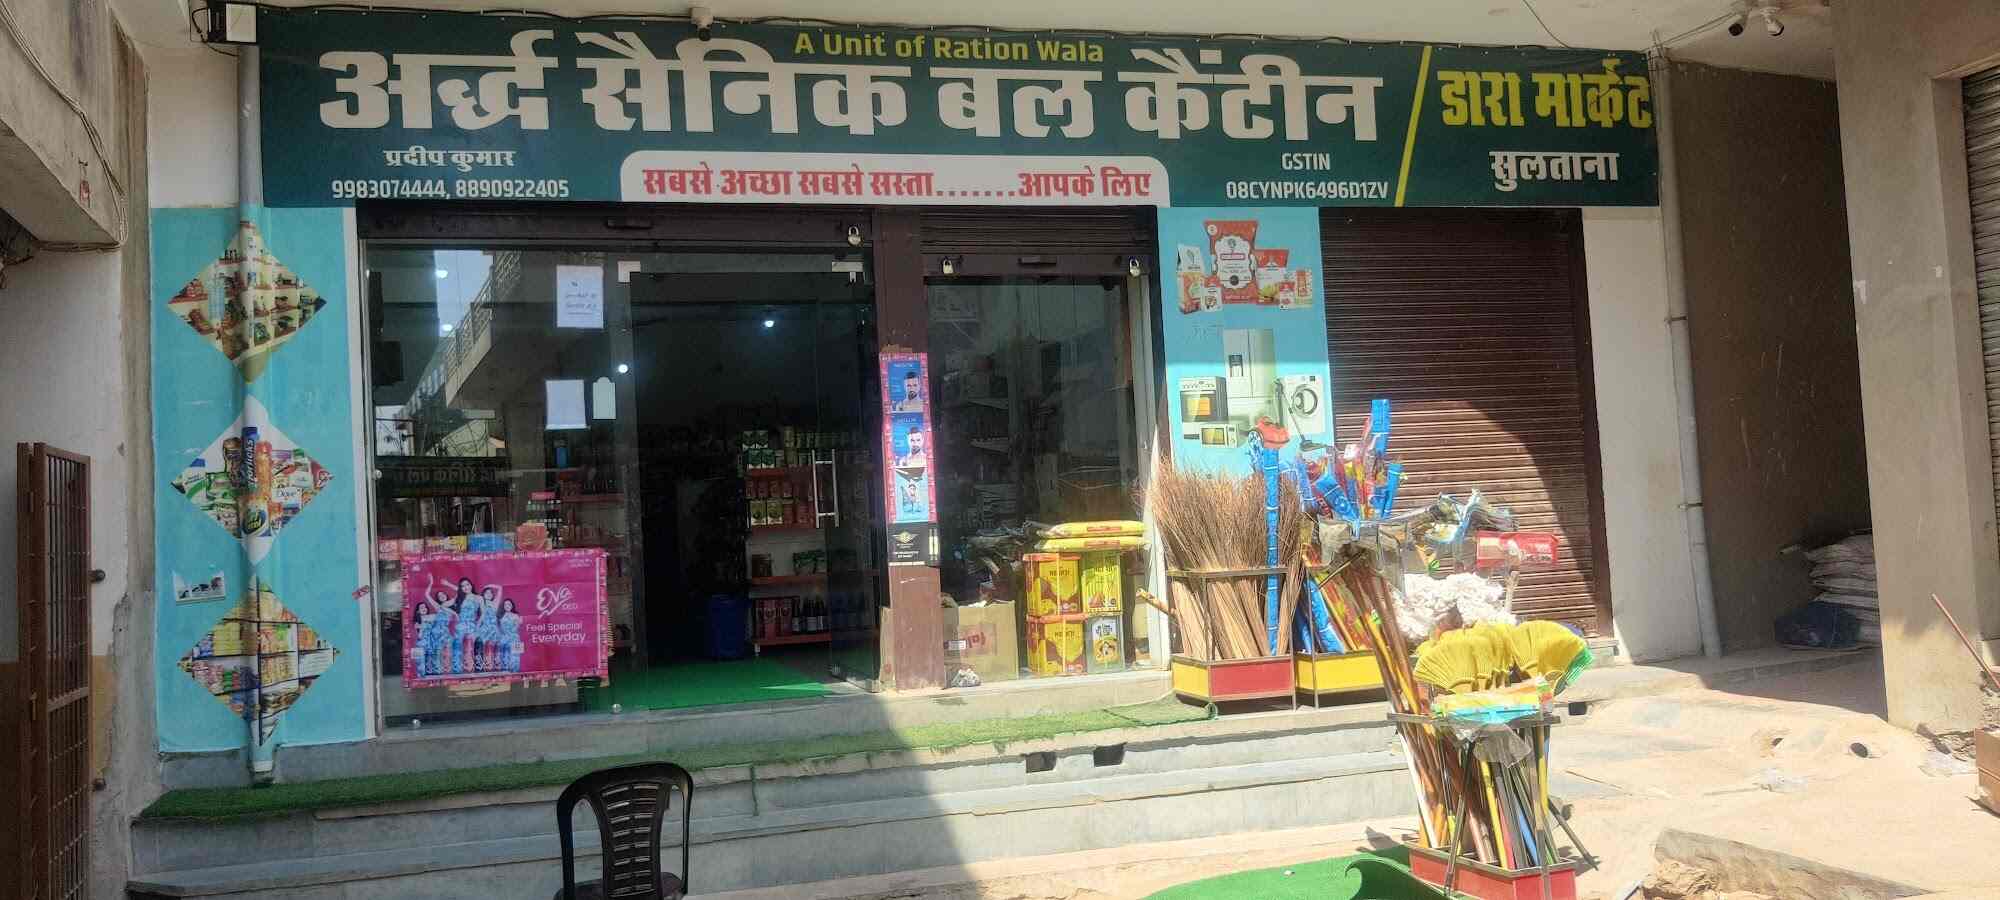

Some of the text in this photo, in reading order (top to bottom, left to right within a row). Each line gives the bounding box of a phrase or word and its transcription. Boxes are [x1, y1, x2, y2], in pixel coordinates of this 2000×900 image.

[795, 32, 1104, 63] A Unit of Ration Wala
[575, 32, 912, 135] सैनिक
[929, 67, 1103, 139] बल
[1117, 48, 1384, 142] कैंटीन
[1437, 70, 1526, 127] डारा
[383, 145, 516, 173] प्रदीप कुमार
[1281, 152, 1331, 171] GSTIN
[1489, 151, 1620, 192] सुलताना
[331, 179, 569, 200] 9983074444, 8890922405
[643, 161, 714, 195] सबसे
[720, 169, 793, 196] अच्छा
[797, 163, 865, 196] सबसे
[1100, 166, 1152, 197] लिए
[526, 622, 583, 633] Feel Special
[531, 631, 587, 644] Everyday
